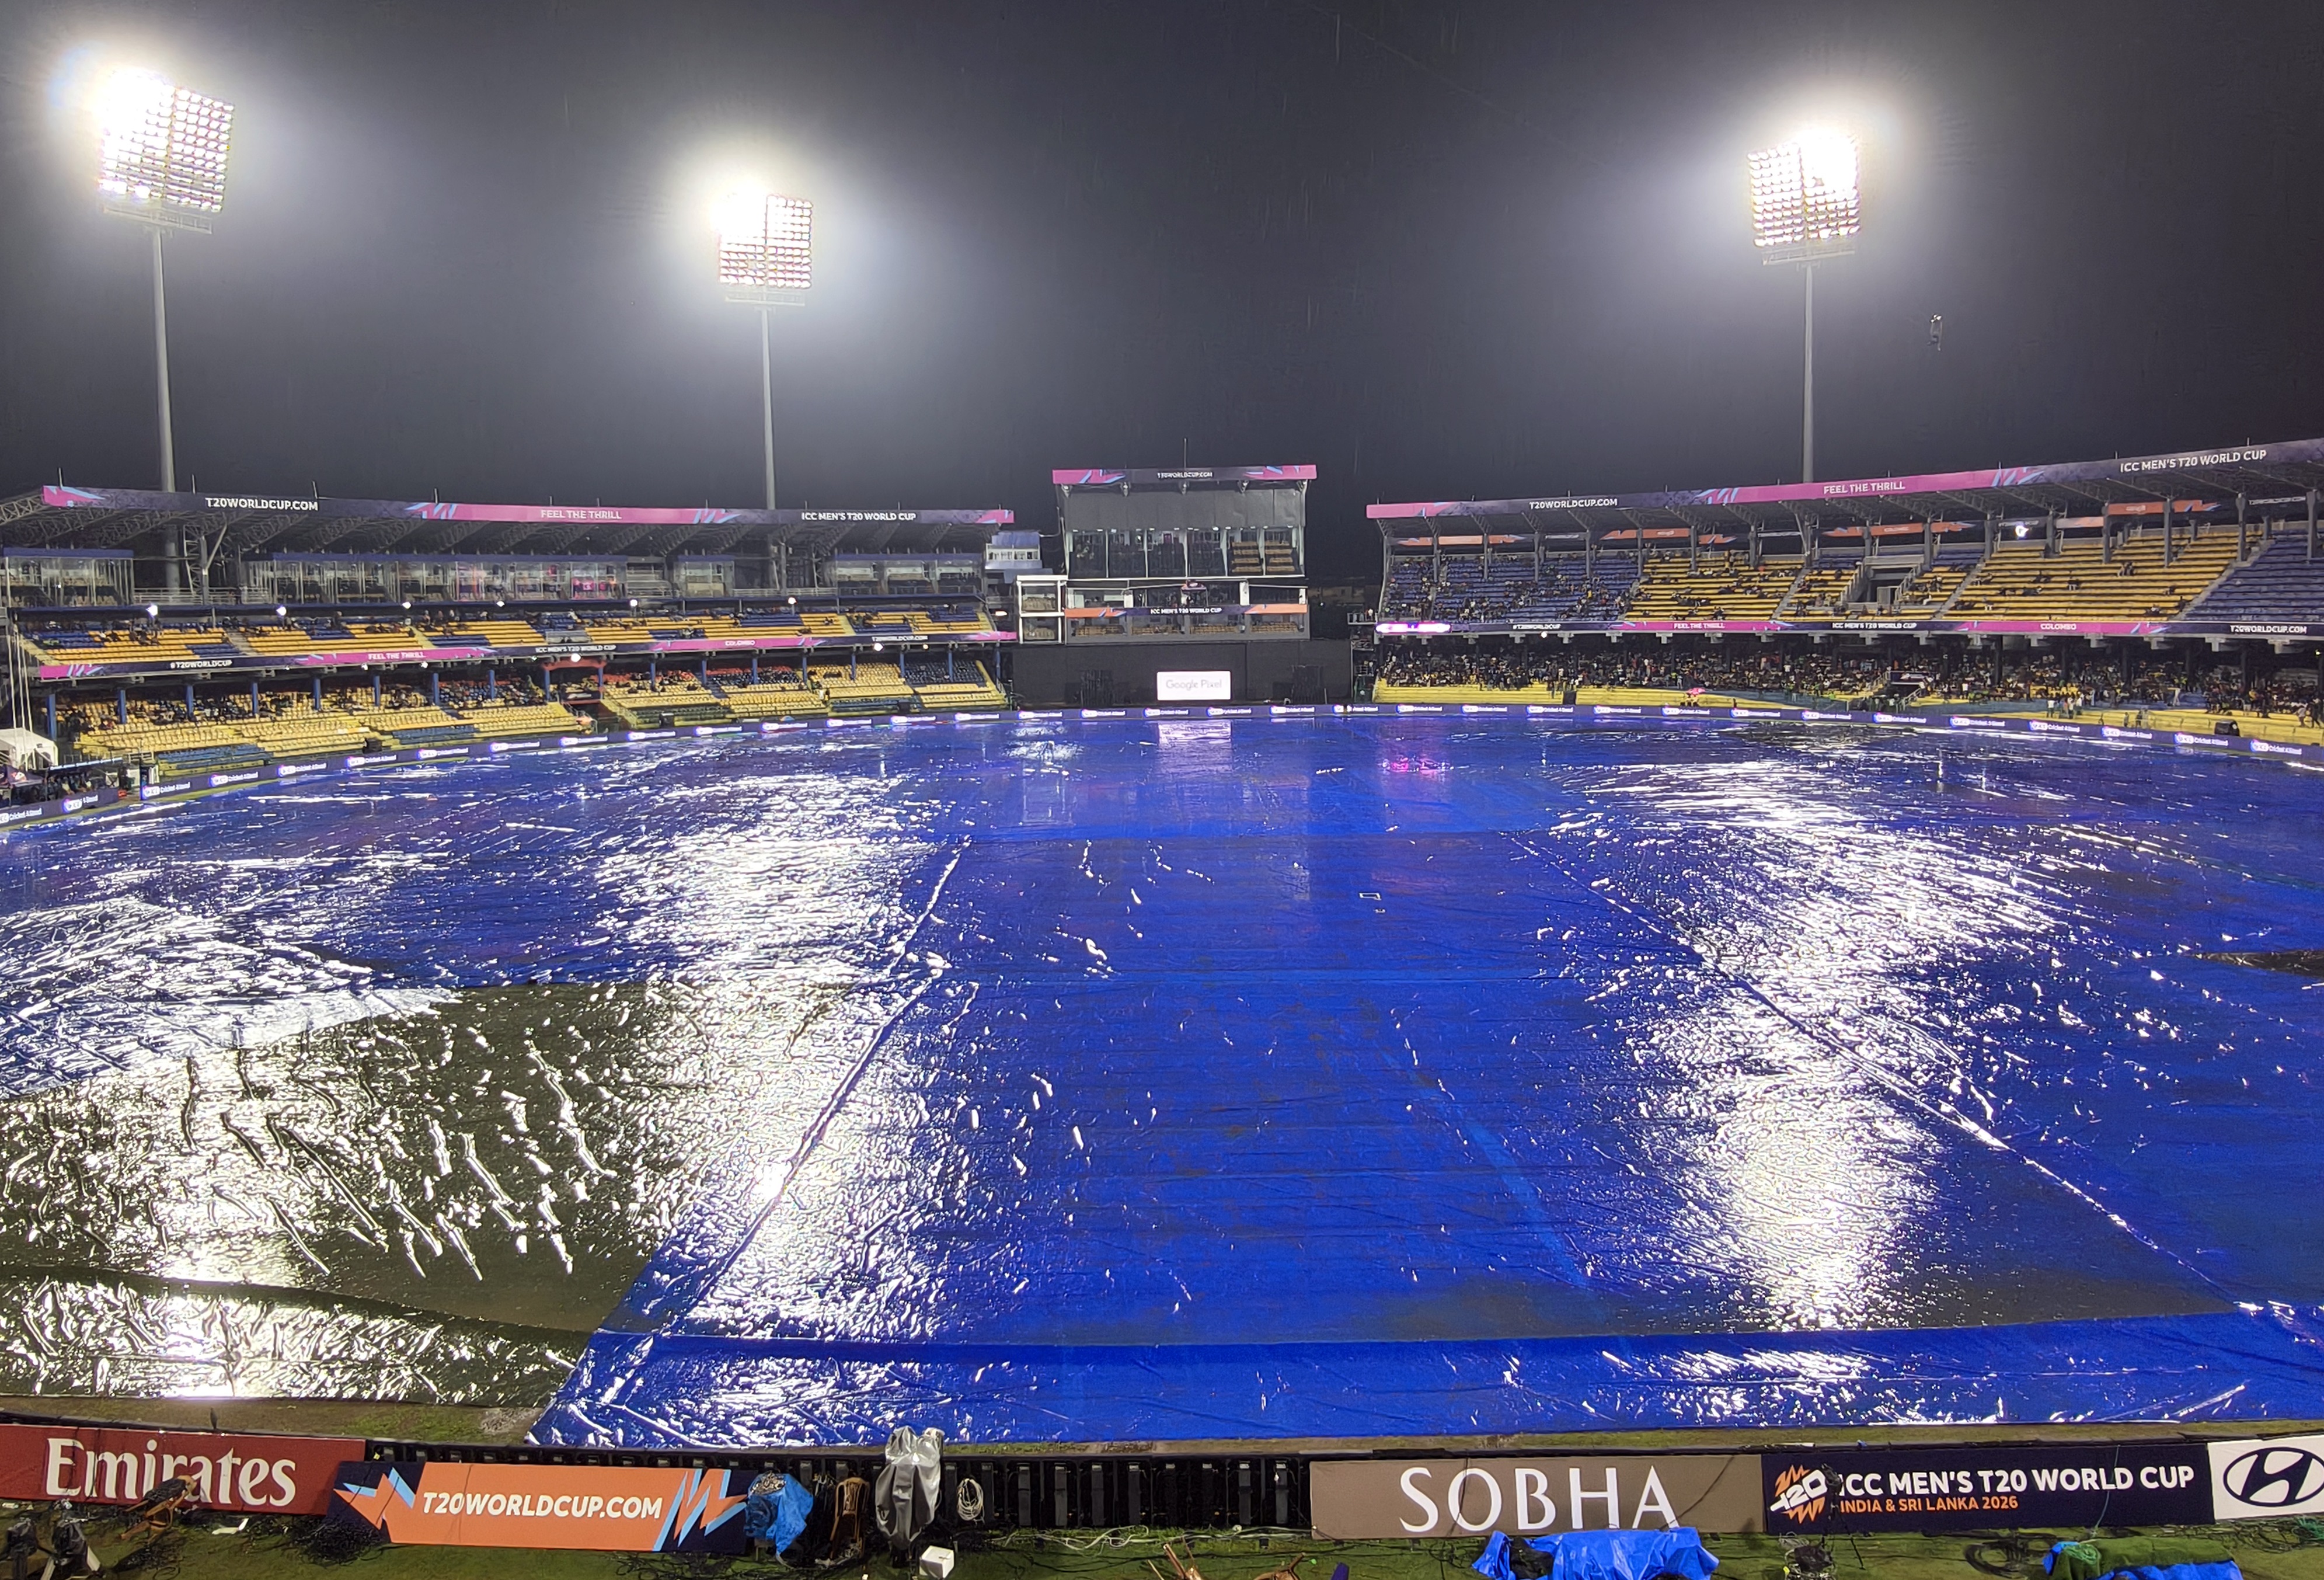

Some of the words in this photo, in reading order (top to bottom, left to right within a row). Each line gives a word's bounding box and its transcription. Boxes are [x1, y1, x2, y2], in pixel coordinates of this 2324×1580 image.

[2120, 462, 2140, 473] ICC
[2141, 459, 2176, 470] MEN'S
[2178, 457, 2198, 468] T20
[2199, 453, 2241, 465] WORLD
[2243, 450, 2267, 461] CUP
[1823, 485, 1848, 495] FEEL
[1849, 483, 1869, 494] THE
[1870, 481, 1906, 491] THRILL
[205, 497, 318, 511] T20WORLDCUP.COM
[1529, 499, 1618, 510] T20WORLDCUP.COM
[541, 510, 565, 518] FEEL
[566, 510, 587, 518] THE
[588, 510, 622, 519] THRILL
[801, 512, 817, 520] ICC
[818, 512, 846, 520] MEN'S
[846, 512, 864, 520] T20
[865, 513, 897, 521] WORLD
[2230, 625, 2307, 634] T20WORLDCUP.COM
[1165, 679, 1198, 691] Google
[1200, 679, 1222, 688] Pixel
[46, 1438, 297, 1507] Emirates
[1838, 1473, 1884, 1497] ICC
[1889, 1470, 1971, 1495] MEN'S
[1977, 1468, 2027, 1494] T20
[2032, 1467, 2134, 1493] WORLD
[2140, 1465, 2195, 1489] CUP
[421, 1491, 663, 1519] T20WORLDCUP.COM
[1399, 1465, 1681, 1532] SOBHA
[1840, 1499, 1883, 1513] INDIA
[1886, 1499, 1896, 1512] &
[1898, 1498, 1922, 1512] SRI
[1926, 1497, 1979, 1511] LANKA
[1982, 1495, 2019, 1510] 2026
